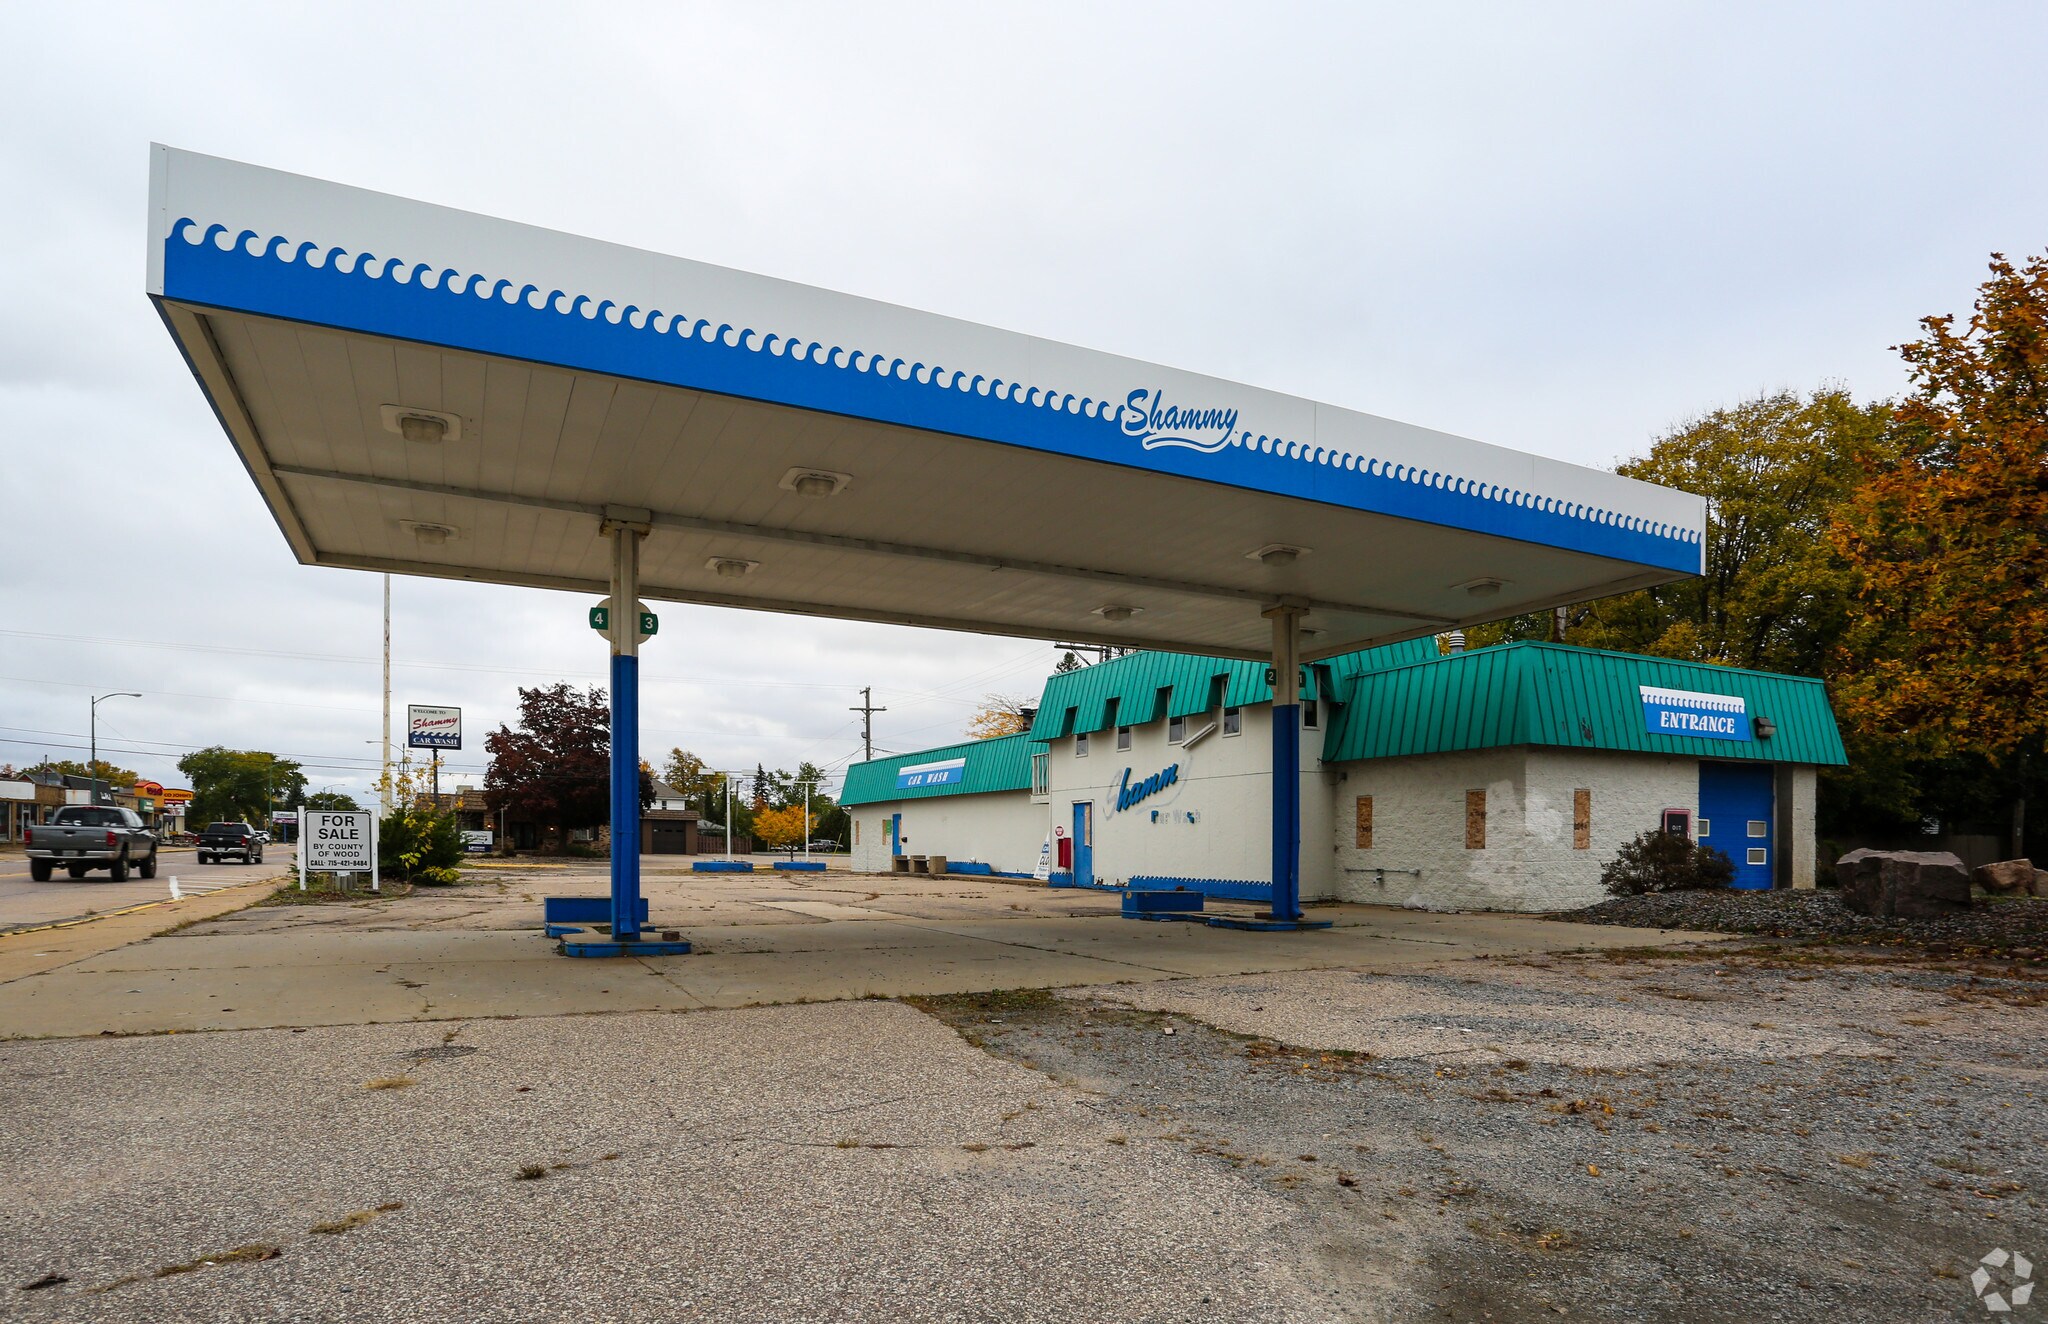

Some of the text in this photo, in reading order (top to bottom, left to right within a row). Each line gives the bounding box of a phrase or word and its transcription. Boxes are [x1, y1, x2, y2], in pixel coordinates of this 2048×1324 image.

[1125, 388, 1238, 449] Shammy
[594, 612, 603, 624] 4
[645, 617, 653, 629] 3
[1268, 671, 1274, 681] 2
[412, 717, 458, 730] Shammy
[1660, 711, 1735, 734] ENTRANCE
[908, 771, 949, 786] CAR WASH
[322, 815, 355, 827] FOR
[318, 828, 359, 840] SALE
